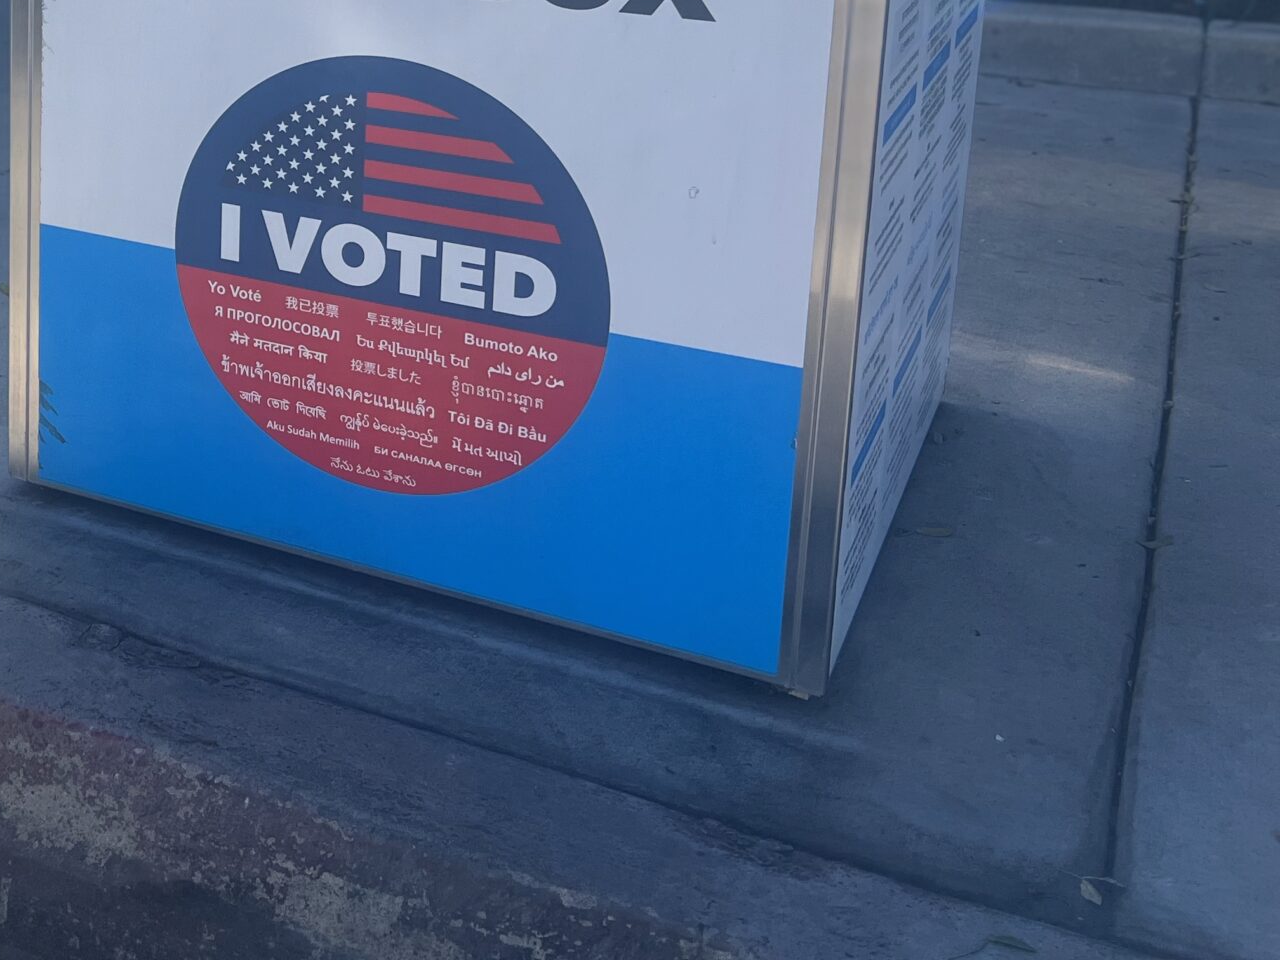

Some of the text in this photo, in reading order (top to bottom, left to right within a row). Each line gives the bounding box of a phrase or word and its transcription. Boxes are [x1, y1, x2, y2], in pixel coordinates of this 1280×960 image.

[220, 202, 557, 317] I VOTED
[207, 280, 263, 303] Yo Voté
[285, 295, 340, 319] 我已投票
[214, 305, 340, 342] Я ПРОГОЛОСОВАЛ
[366, 311, 443, 340] 투표했습니다
[253, 337, 295, 357] मतदान
[298, 344, 328, 364] किया
[464, 332, 558, 362] Bumoto Ako
[350, 358, 422, 385] 投票しました
[545, 374, 565, 389] من
[239, 390, 262, 405] আমি
[267, 396, 291, 412] ভোট
[267, 419, 360, 451] Aku Sudah Memilih
[448, 410, 547, 444] Tôi Đã Đi Bầu
[374, 445, 482, 479] БИ САНАЛАА ӨГСӨН
[464, 442, 484, 458] મત
